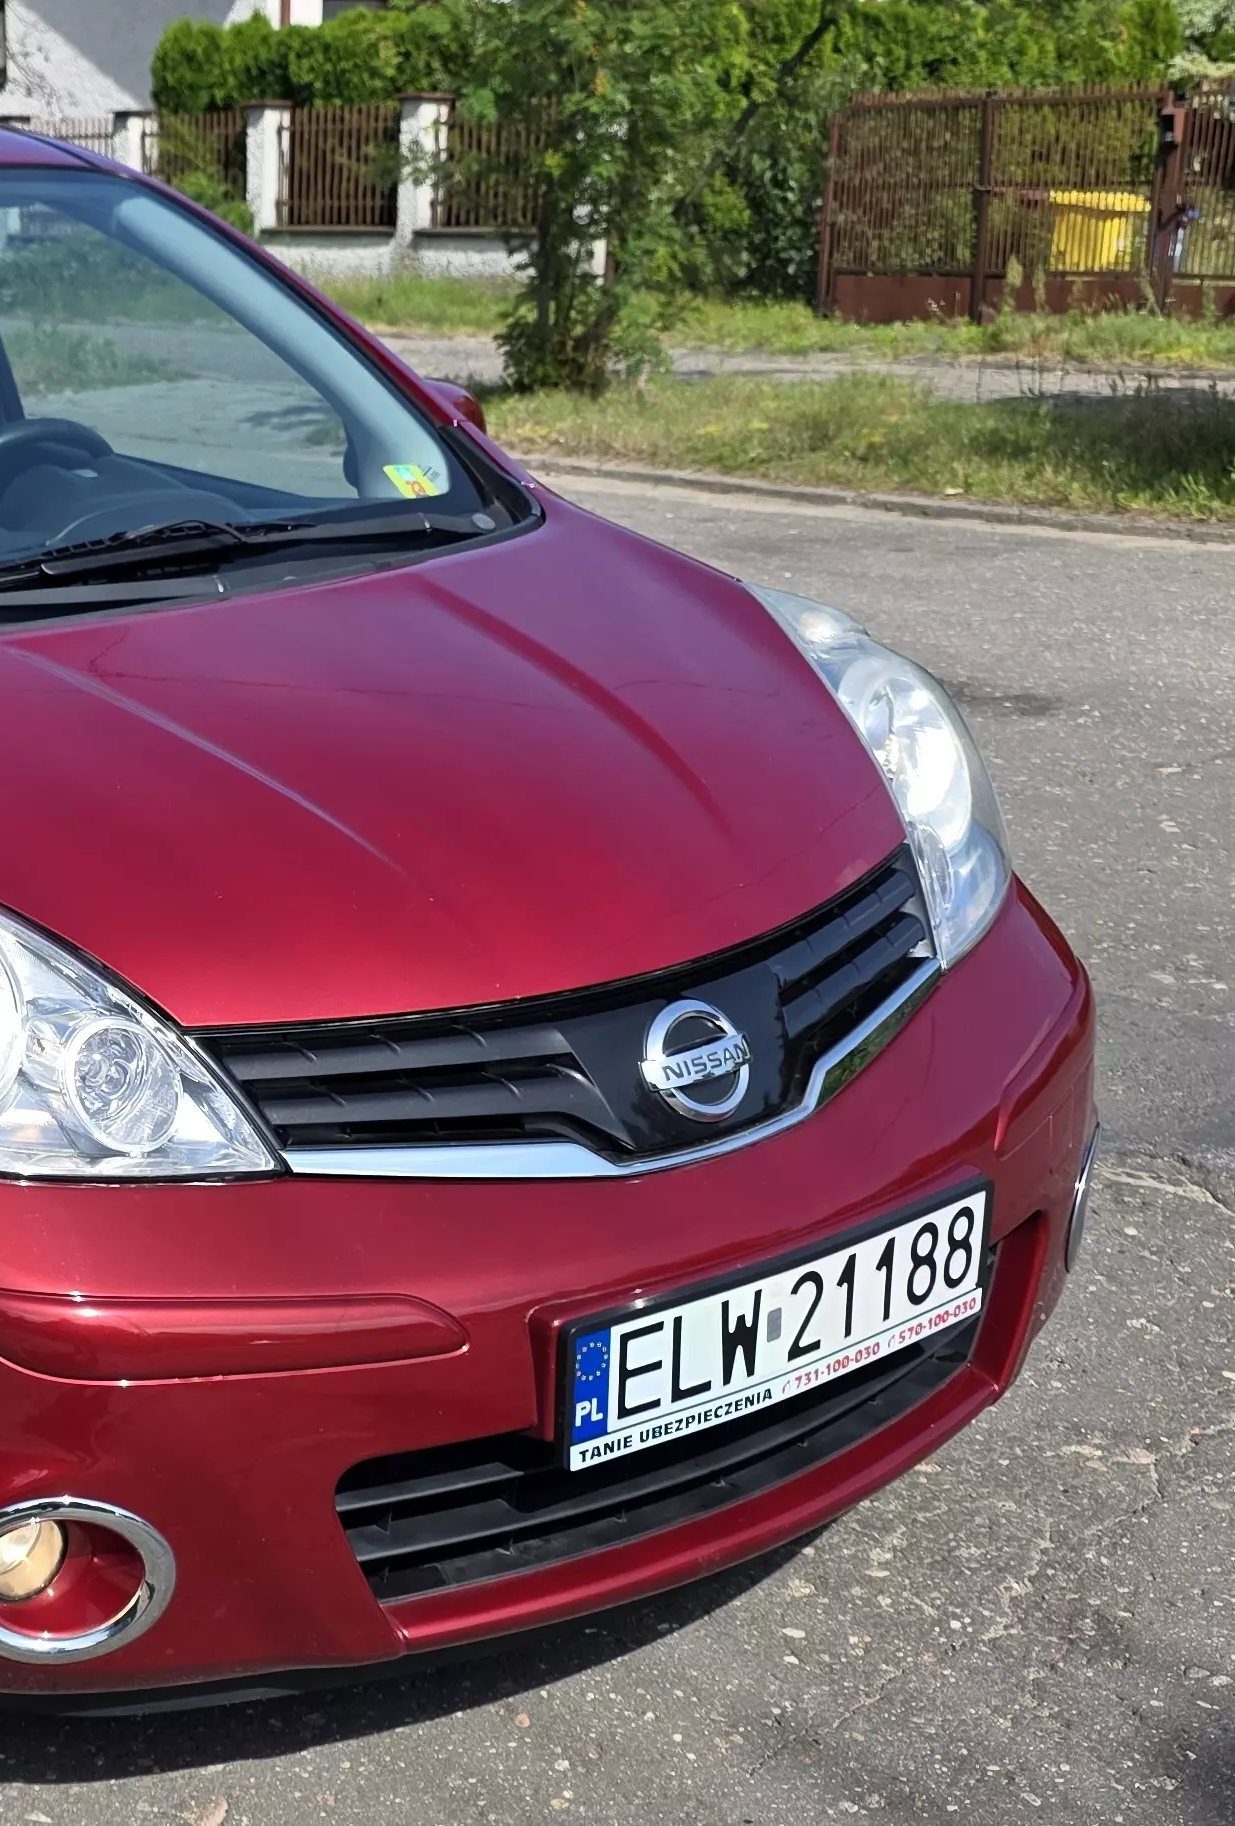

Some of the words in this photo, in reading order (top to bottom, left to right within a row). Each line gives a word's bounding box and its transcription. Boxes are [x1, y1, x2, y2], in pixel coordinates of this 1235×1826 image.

[662, 1042, 749, 1082] NISSAN
[617, 1288, 763, 1420] ELW
[787, 1206, 975, 1362] 21188
[575, 1397, 604, 1427] PL
[579, 1434, 633, 1463] TANIE
[639, 1387, 773, 1444] UBEZPIECZENIA
[794, 1340, 881, 1390] 731-100-030
[898, 1296, 977, 1345] 570-100-030
